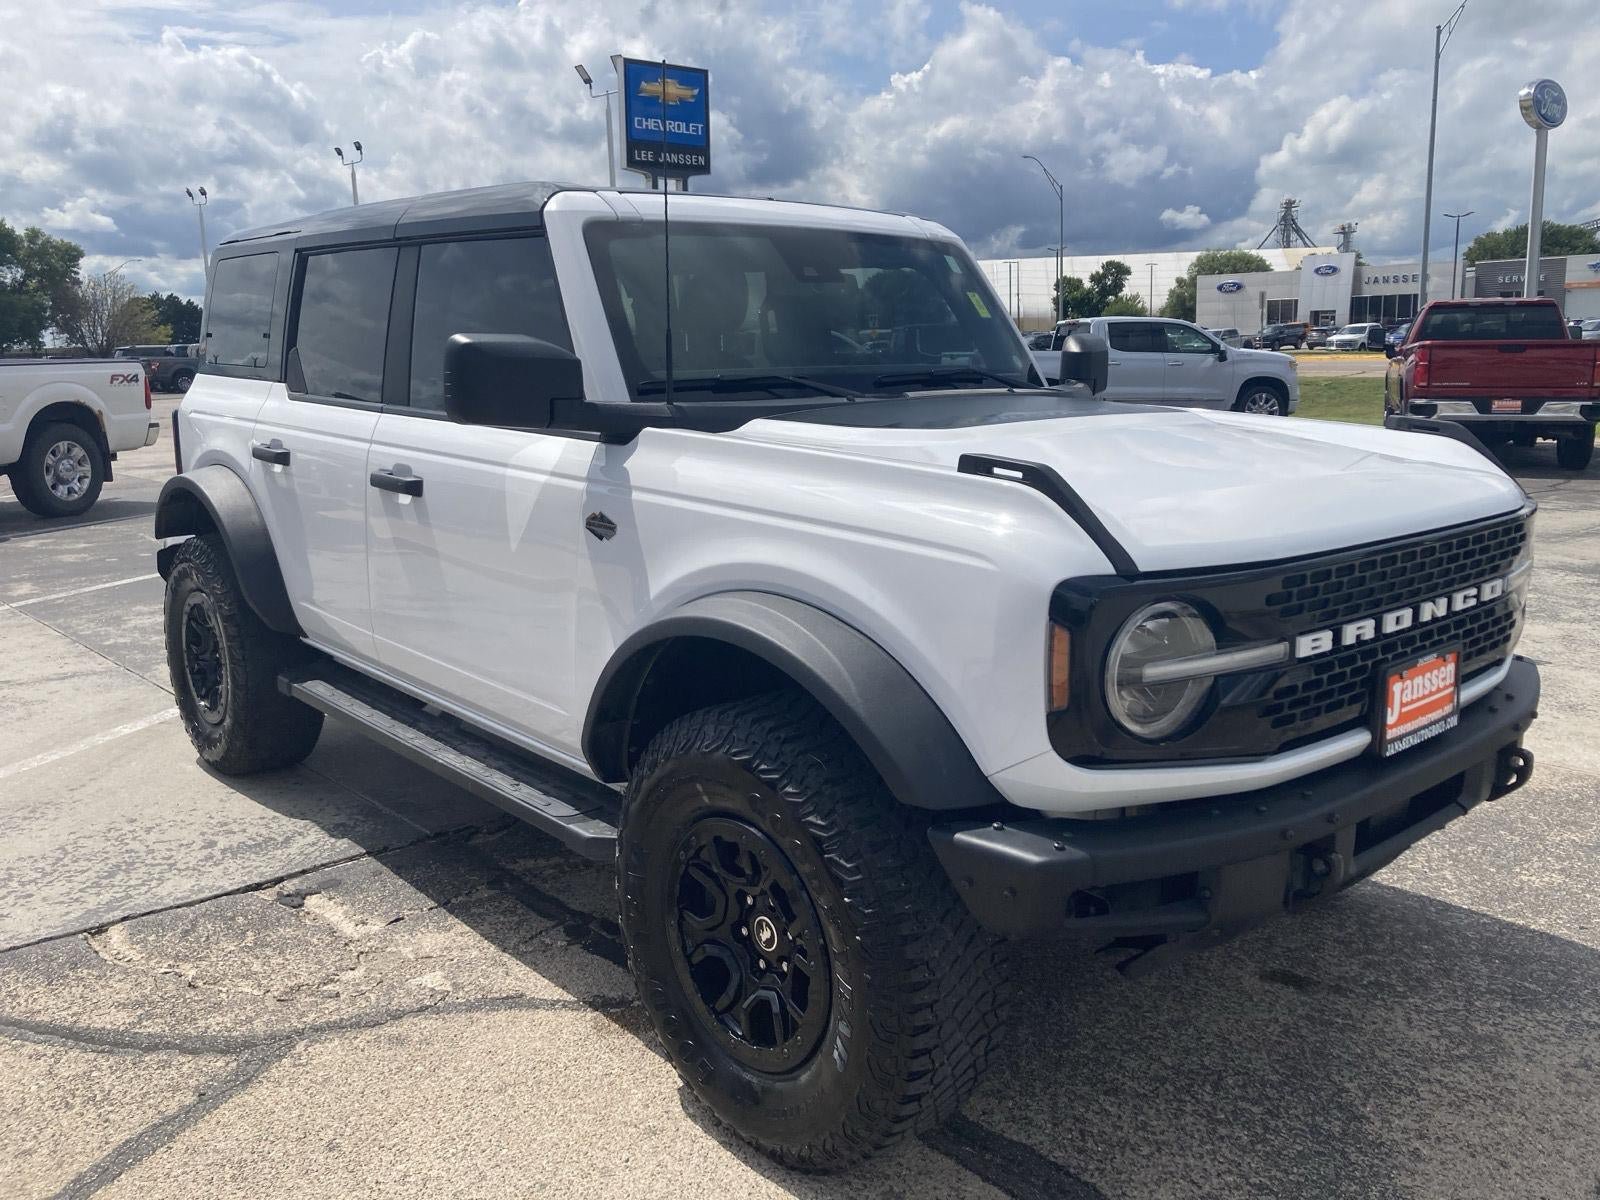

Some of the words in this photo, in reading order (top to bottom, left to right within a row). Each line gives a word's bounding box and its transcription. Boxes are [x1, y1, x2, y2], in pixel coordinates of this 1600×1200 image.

[634, 117, 704, 135] CHEVROLET
[634, 149, 654, 162] LEE
[659, 151, 705, 166] JANSSEN
[1365, 273, 1427, 285] JANSSE
[1497, 273, 1546, 284] SERVE
[110, 373, 139, 384] FX4
[1295, 578, 1504, 658] BRONCO
[1386, 662, 1456, 726] Janssen
